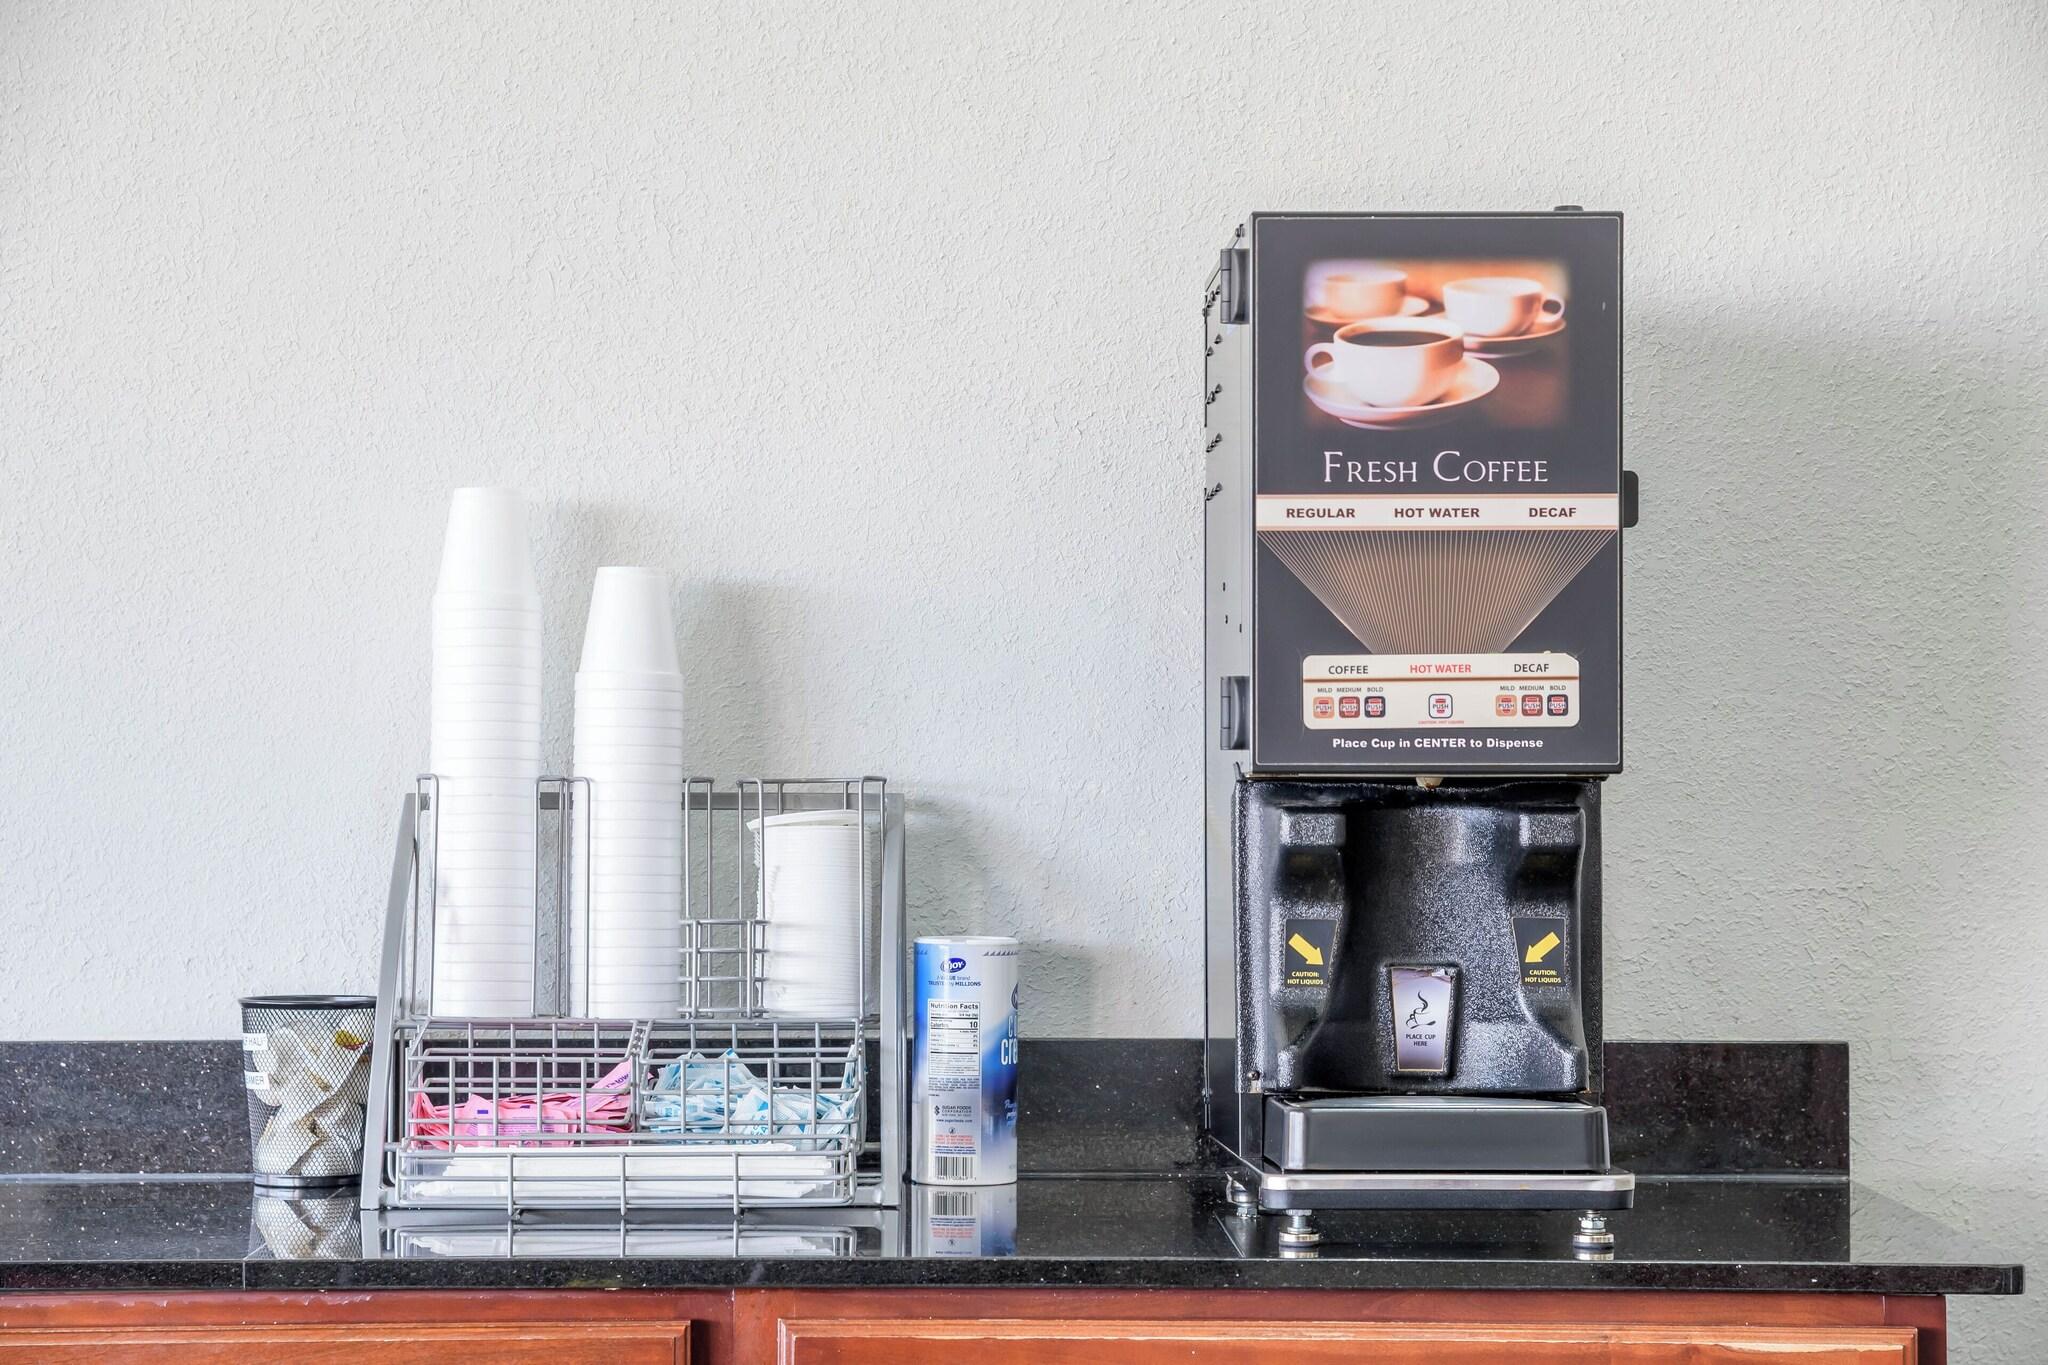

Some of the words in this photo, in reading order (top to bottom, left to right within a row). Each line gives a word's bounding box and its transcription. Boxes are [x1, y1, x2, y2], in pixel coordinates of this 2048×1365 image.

[1323, 450, 1417, 483] FRESH
[1432, 450, 1549, 483] COFFEE
[1285, 507, 1356, 519] REGULAR
[1394, 507, 1425, 518] HOT
[1429, 507, 1480, 518] WATER
[1528, 507, 1577, 518] DECAF
[1328, 665, 1369, 675] COFFEE
[1409, 664, 1433, 674] HOT
[1435, 664, 1472, 673] WATER
[1513, 663, 1550, 673] DECAF
[1332, 738, 1368, 748] Place
[1371, 738, 1396, 750] Cup
[1399, 738, 1411, 748] in
[1414, 738, 1466, 748] CENTER
[1470, 738, 1483, 748] to
[1486, 737, 1544, 750] Dispense
[969, 1021, 978, 1029] 10
